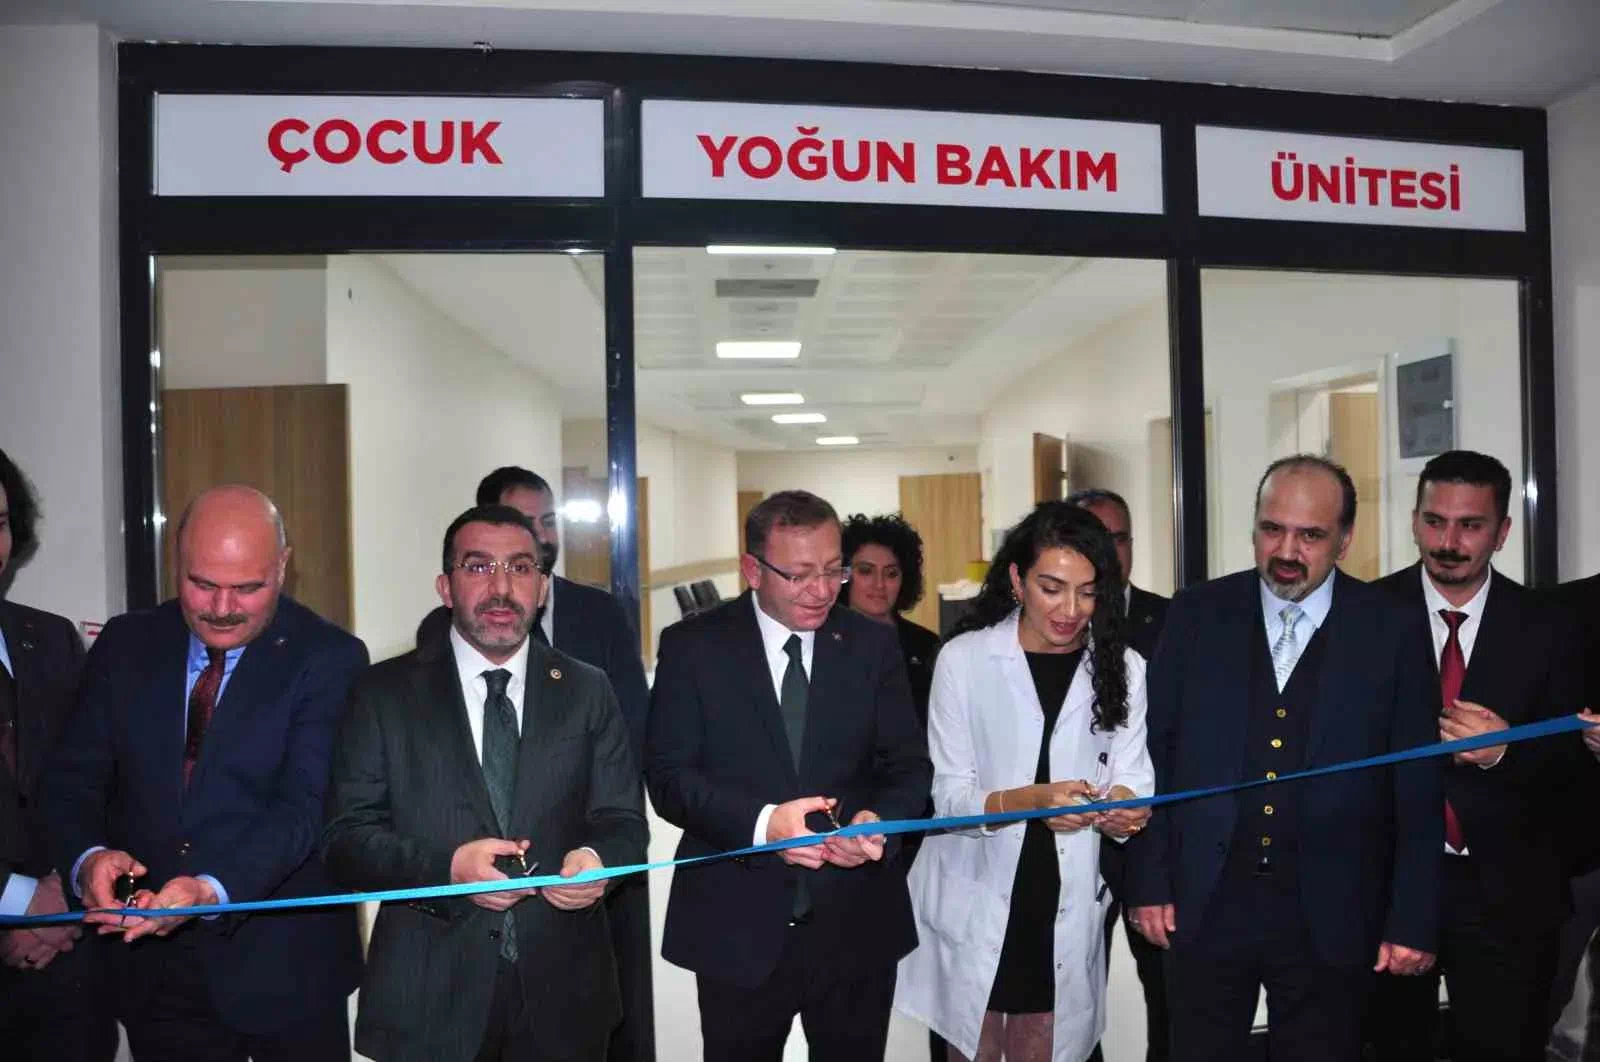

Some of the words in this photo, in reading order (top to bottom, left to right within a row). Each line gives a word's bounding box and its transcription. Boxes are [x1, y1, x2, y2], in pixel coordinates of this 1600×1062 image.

[267, 118, 502, 173] ÇOCUK
[698, 126, 917, 184] YOĞUN
[936, 144, 1118, 193] BAKIM
[1271, 152, 1461, 210] ÜNİTESİ
